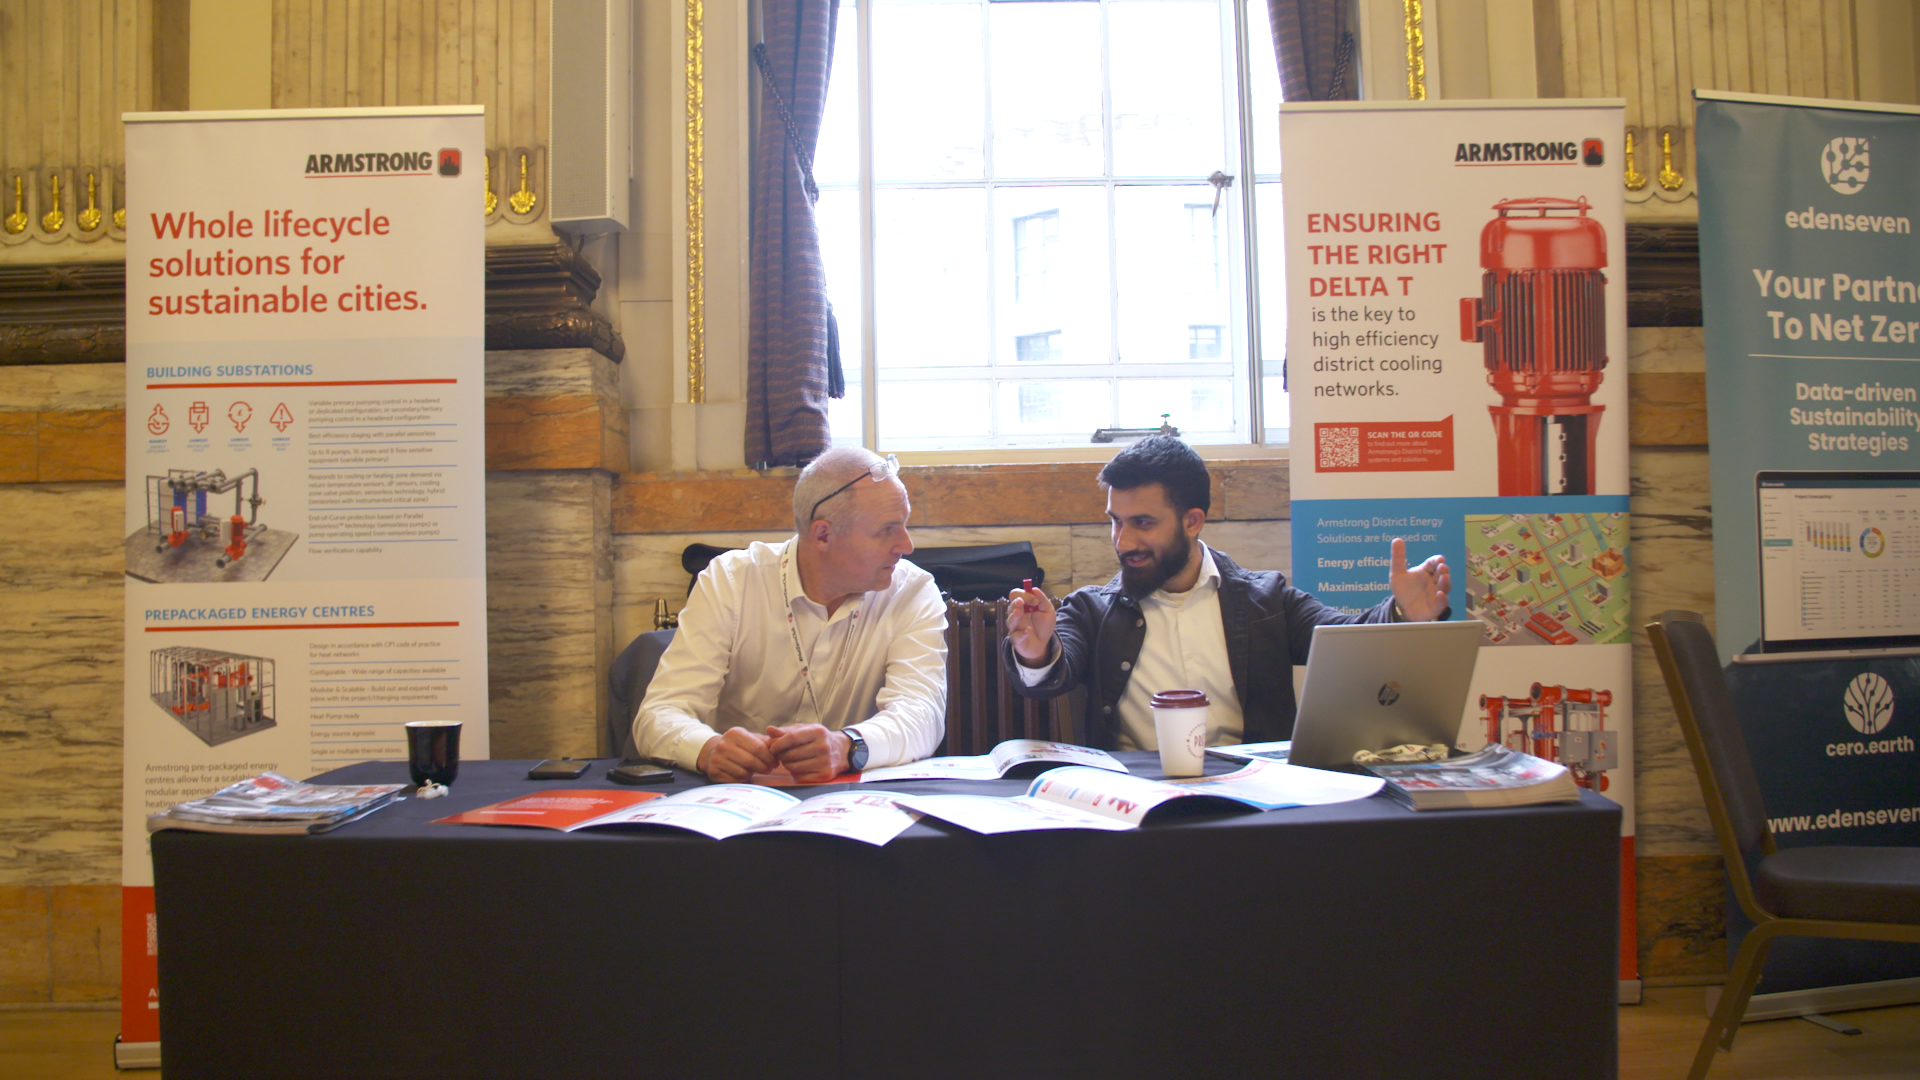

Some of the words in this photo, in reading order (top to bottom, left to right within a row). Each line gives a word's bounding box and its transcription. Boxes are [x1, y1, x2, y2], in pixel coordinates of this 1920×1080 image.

[1455, 142, 1577, 162] ARMSTRONG
[305, 152, 432, 173] ARMSTRONG
[151, 211, 253, 239] Whole
[264, 208, 389, 242] lifecycle
[1307, 212, 1440, 233] ENSURING
[1786, 207, 1910, 234] edenseven
[150, 249, 290, 277] solutions
[301, 248, 345, 275] for
[1307, 245, 1359, 264] THE
[1368, 244, 1447, 264] RIGHT
[1310, 277, 1389, 297] DELTA
[1398, 276, 1413, 296] T
[1753, 269, 1825, 300] Your
[1834, 273, 1920, 303] Partn
[149, 285, 327, 315] sustainable
[338, 284, 427, 312] cities.
[1312, 307, 1326, 322] is
[1331, 306, 1358, 321] the
[1364, 306, 1392, 324] key
[1398, 308, 1415, 321] to
[1768, 311, 1802, 340] To
[1810, 313, 1864, 342] Net
[1871, 316, 1920, 343] Zer
[1313, 331, 1350, 350] high
[1355, 331, 1439, 349] efficiency
[147, 366, 212, 378] BUILDING
[216, 365, 313, 376] SUBSTATIONS
[1314, 357, 1374, 372] district
[1380, 356, 1442, 374] cooling
[1314, 381, 1399, 397] networks.
[1796, 382, 1916, 402] Data-driven
[1790, 407, 1920, 432] Sustainability
[1809, 432, 1908, 457] Strategies
[1317, 518, 1369, 530] Armstrong
[1372, 518, 1407, 526] District
[1409, 517, 1442, 529] Energy
[1317, 534, 1362, 543] Solutions
[1318, 558, 1353, 570] Energy
[1318, 582, 1390, 592] Maximisation
[145, 608, 247, 621] PREPACKAGED
[252, 607, 308, 619] ENERGY
[313, 606, 374, 618] CENTRES
[1826, 736, 1914, 757] cero.earth
[146, 764, 189, 773] Armstrong
[191, 763, 248, 772] pre-packaged
